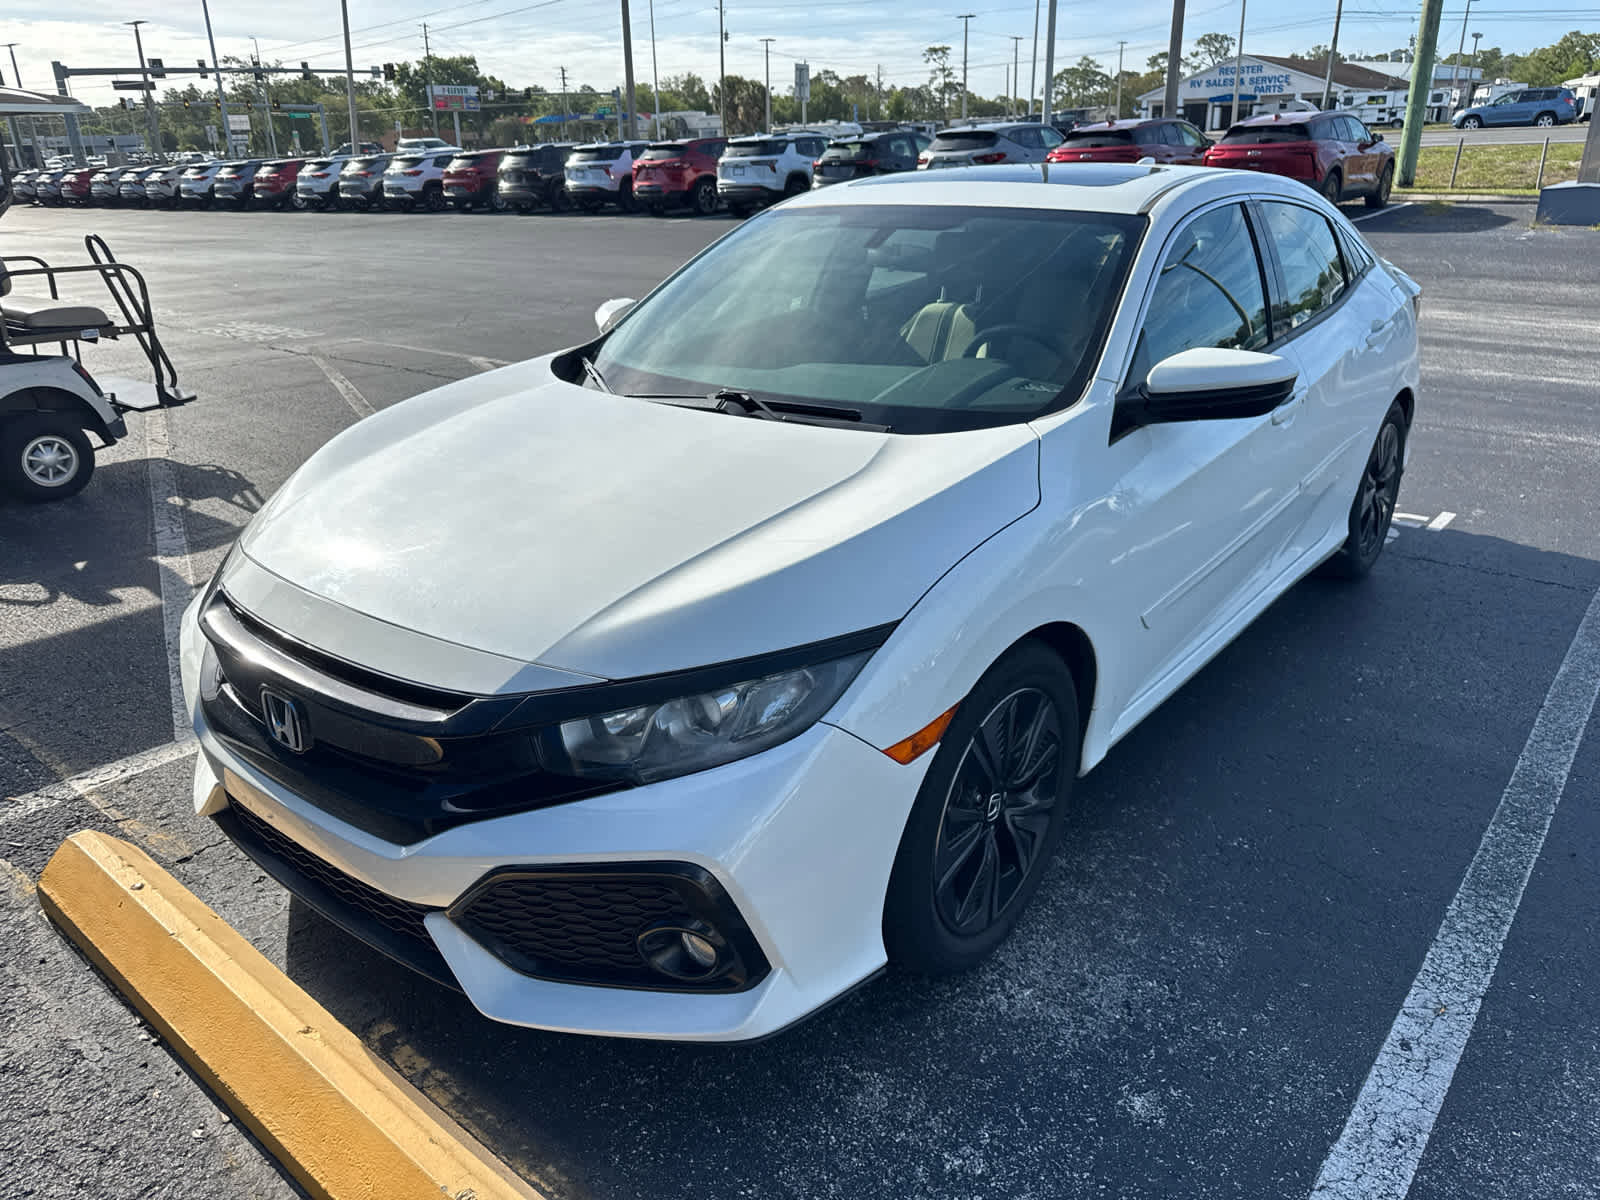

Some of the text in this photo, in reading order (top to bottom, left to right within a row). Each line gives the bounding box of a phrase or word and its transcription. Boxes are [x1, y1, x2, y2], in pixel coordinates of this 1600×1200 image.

[1219, 65, 1263, 76] REGSTER
[1190, 79, 1203, 88] RV
[1205, 78, 1235, 88] SALES
[1249, 75, 1290, 85] SERVICE
[1254, 84, 1284, 94] PARTS
